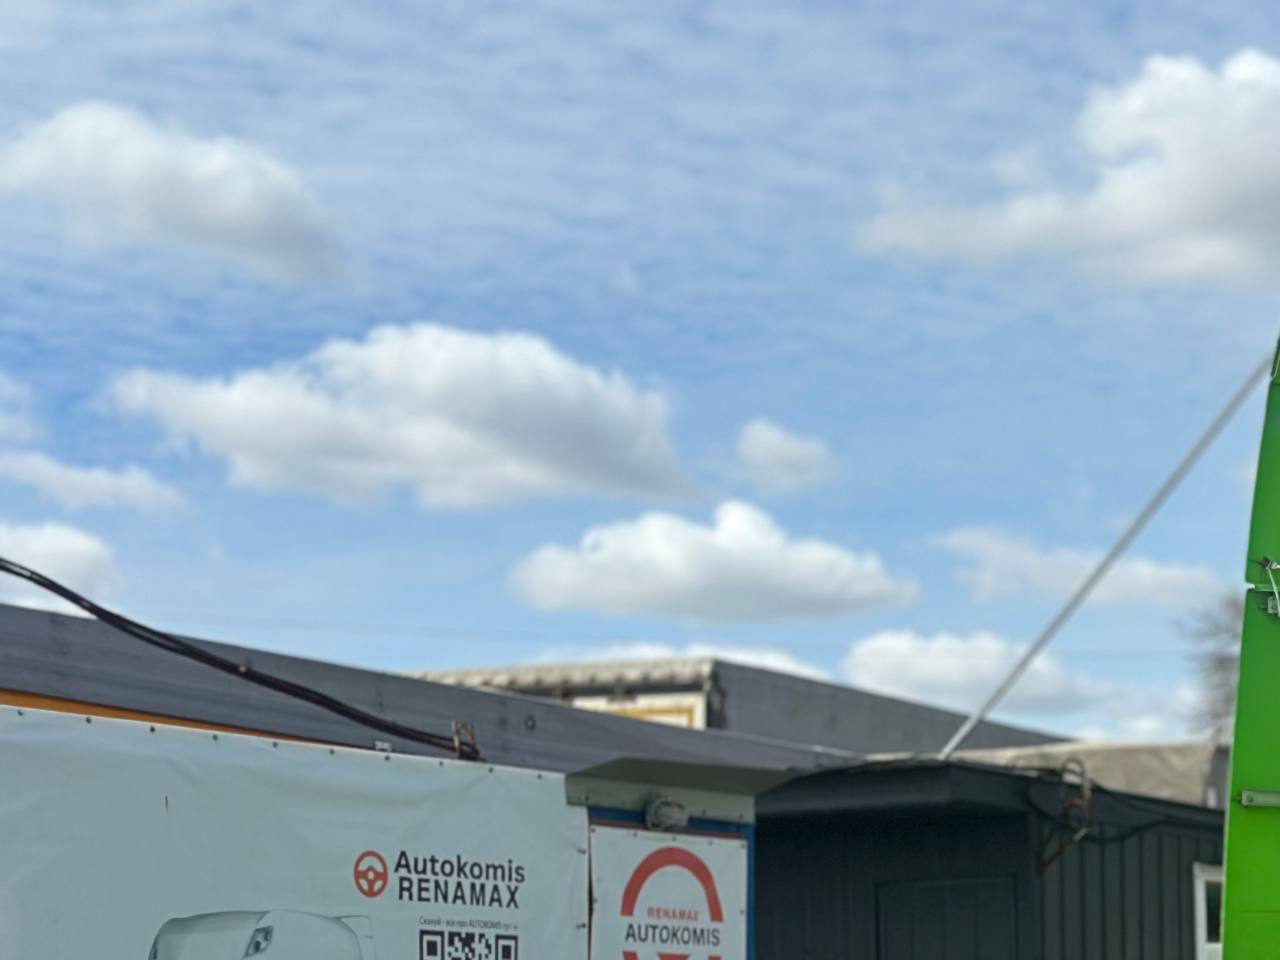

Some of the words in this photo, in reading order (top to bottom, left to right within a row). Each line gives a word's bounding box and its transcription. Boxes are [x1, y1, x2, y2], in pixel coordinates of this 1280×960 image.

[394, 850, 525, 884] Autokomis
[398, 876, 519, 909] RENAMAX
[647, 906, 699, 921] RENAMAX
[625, 923, 721, 947] AUTOKOMIS
